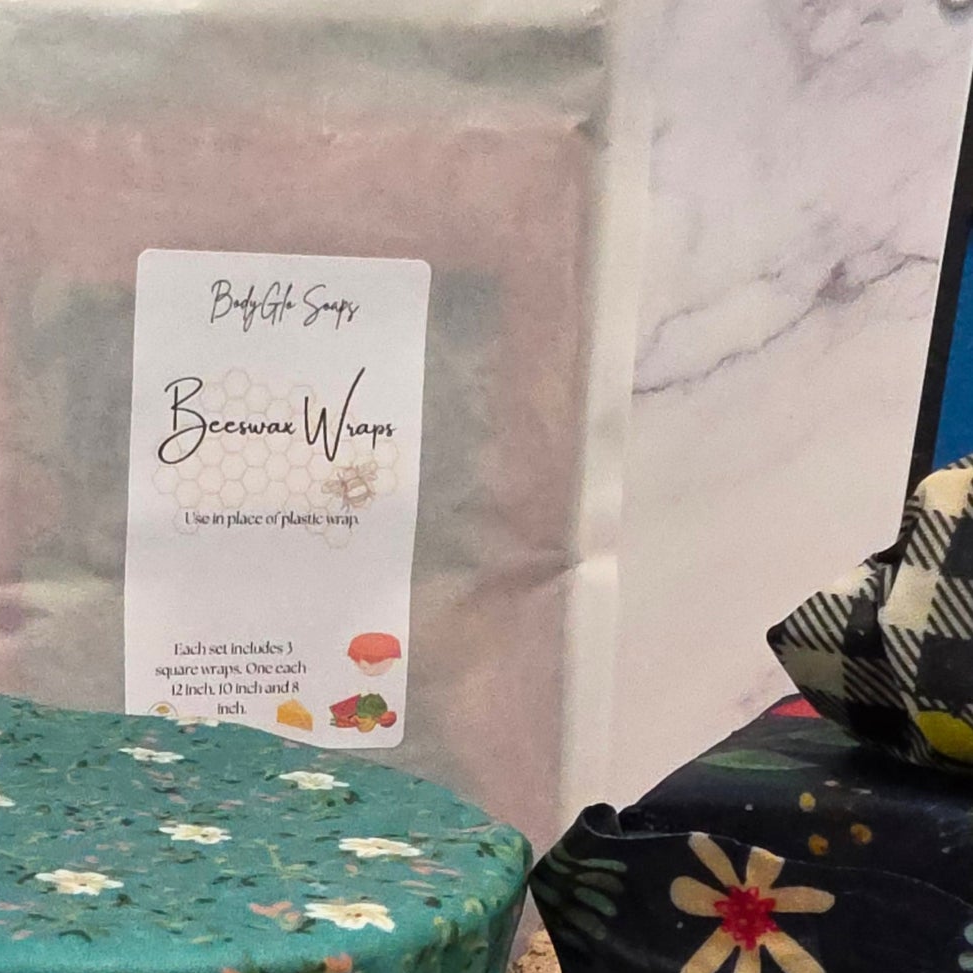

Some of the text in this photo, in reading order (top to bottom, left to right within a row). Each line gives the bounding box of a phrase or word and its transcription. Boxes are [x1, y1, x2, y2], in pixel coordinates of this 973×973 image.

[303, 284, 360, 330] Soaps
[157, 366, 397, 465] Beeswax Wraps
[184, 511, 210, 526] Use
[212, 511, 225, 525] in
[227, 511, 264, 529] place
[265, 511, 281, 526] of
[281, 511, 324, 529] plastic
[174, 640, 294, 656] Each set includes 3
[155, 664, 199, 680] square
[245, 661, 274, 675] One
[275, 660, 307, 675] each
[171, 683, 184, 697] 12
[218, 682, 233, 696] 10
[235, 680, 263, 696] inch
[264, 680, 290, 695] and
[291, 681, 300, 694] 8
[216, 700, 248, 715] inch.
